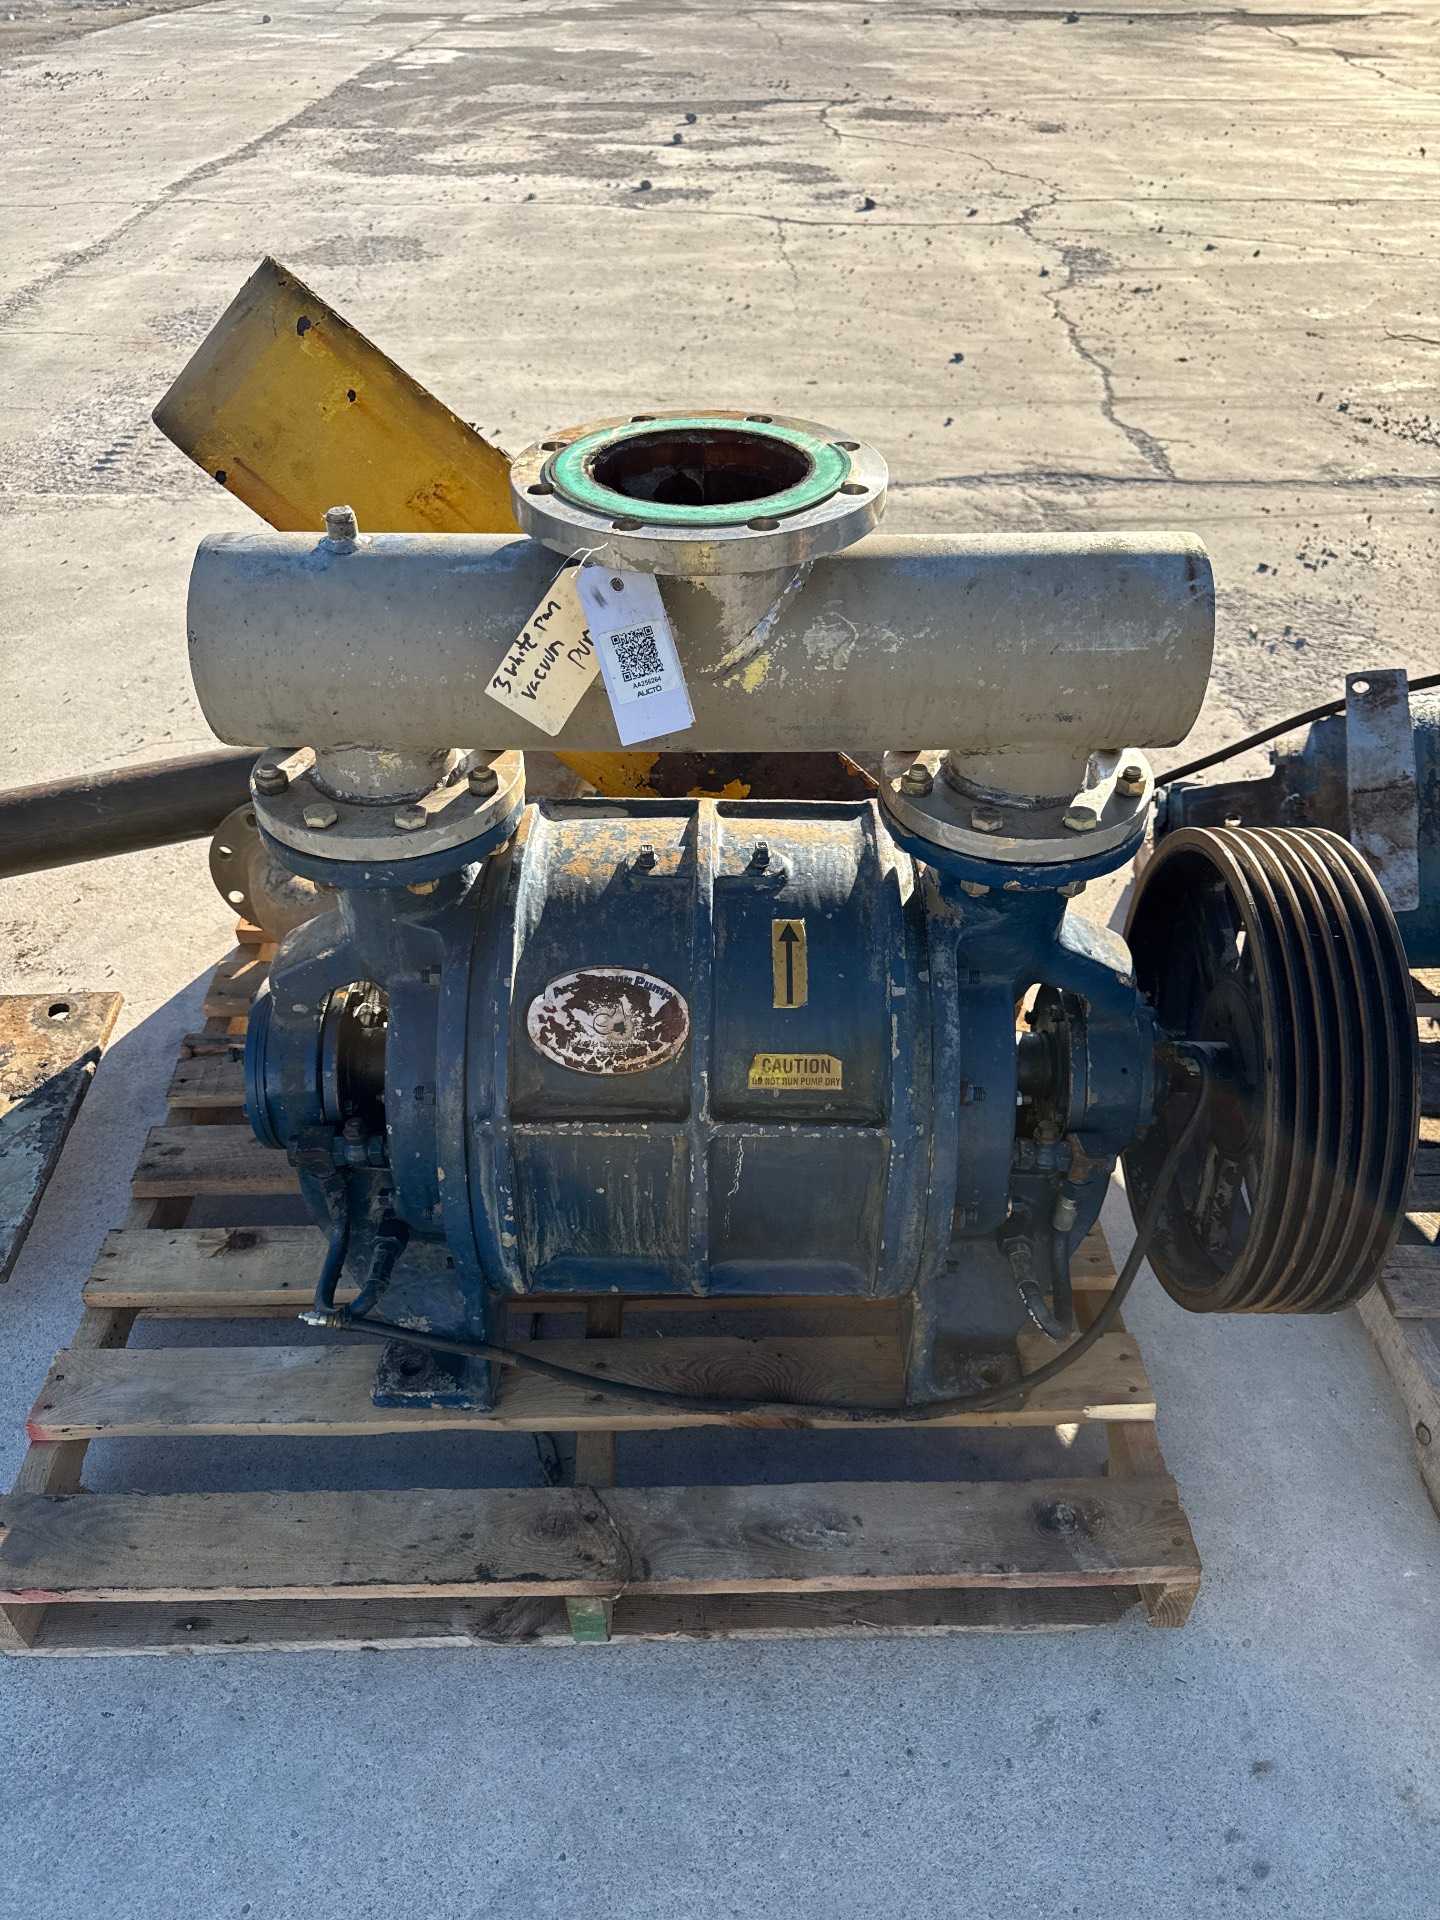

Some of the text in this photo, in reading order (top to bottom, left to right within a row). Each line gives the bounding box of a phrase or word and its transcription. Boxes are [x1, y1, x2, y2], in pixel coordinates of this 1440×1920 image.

[492, 675, 512, 694] 3
[762, 1058, 831, 1073] CAUTION
[764, 1076, 781, 1086] NOT
[782, 1077, 799, 1086] RUN
[800, 1077, 823, 1086] PUMP
[824, 1077, 840, 1086] DRY
